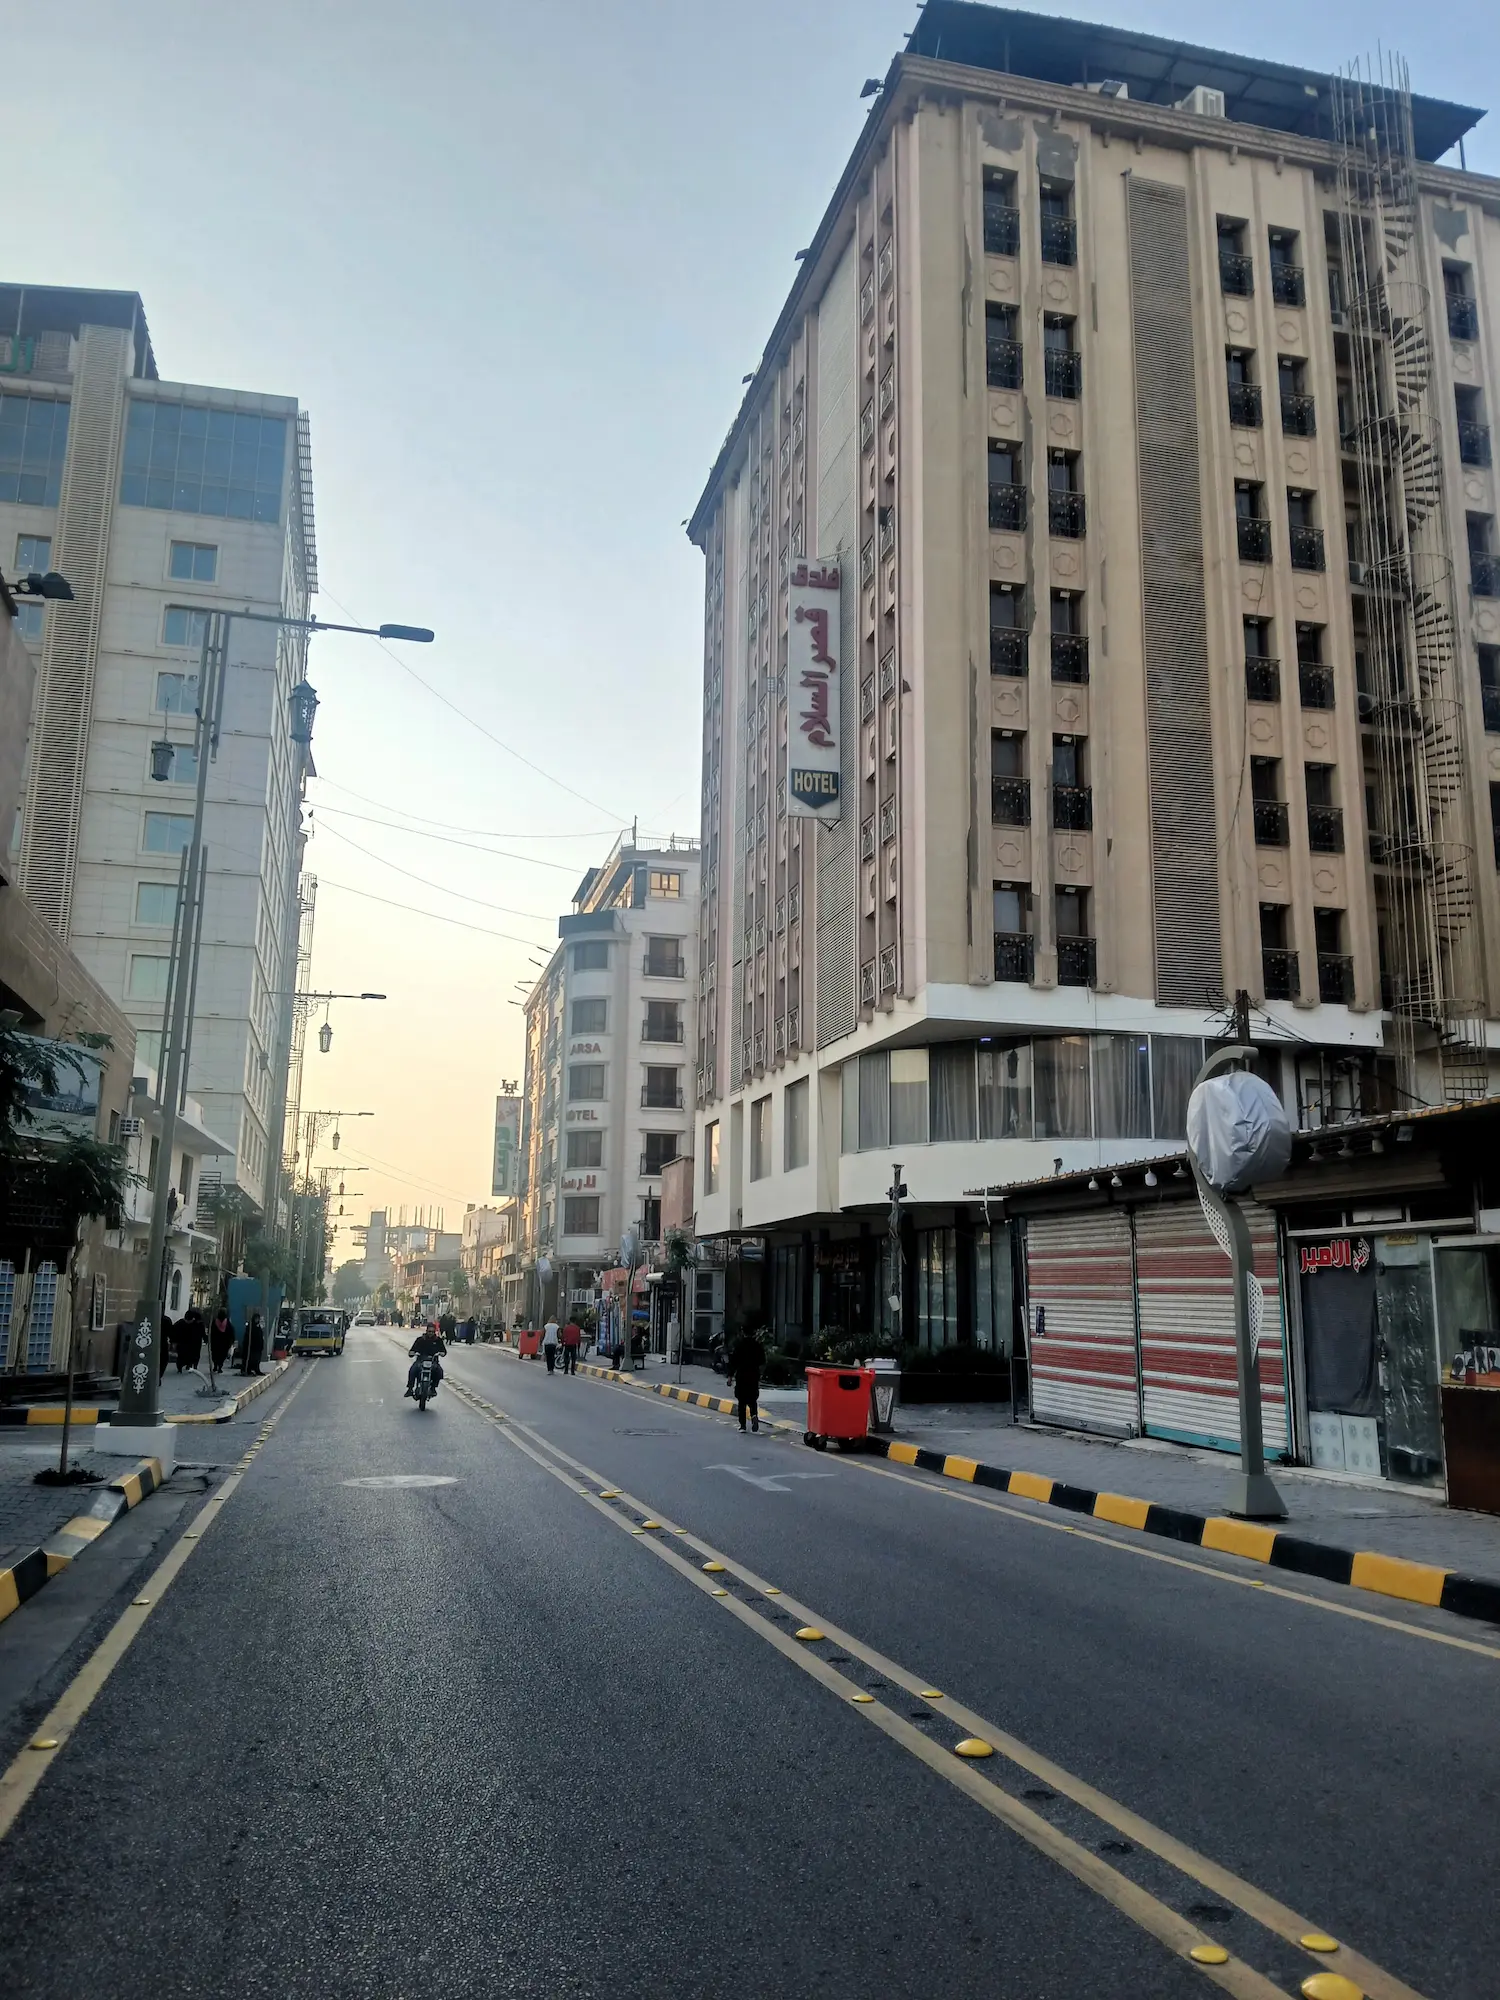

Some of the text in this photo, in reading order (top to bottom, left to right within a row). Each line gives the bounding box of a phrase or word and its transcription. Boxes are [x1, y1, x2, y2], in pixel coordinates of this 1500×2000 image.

[791, 564, 839, 590] فندق
[794, 604, 836, 748] قصر السلام
[794, 771, 837, 794] HOTEL
[1299, 1238, 1352, 1274] الامير
